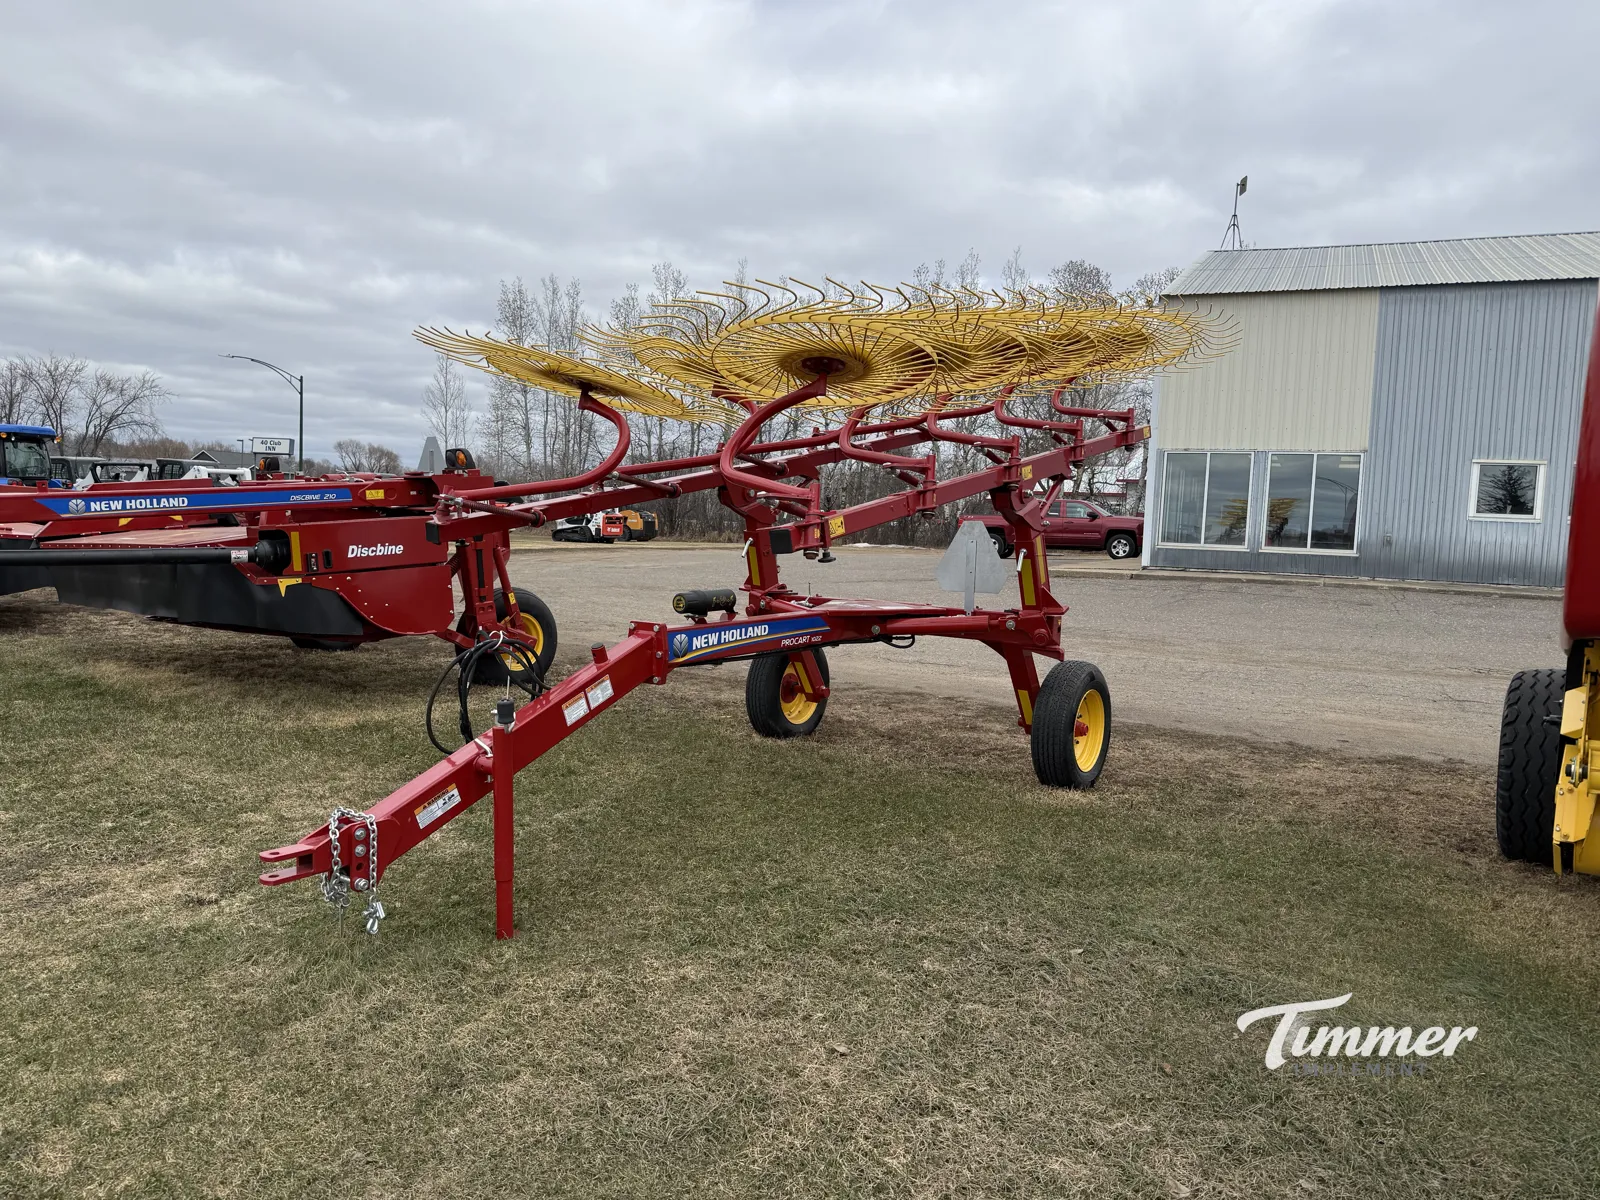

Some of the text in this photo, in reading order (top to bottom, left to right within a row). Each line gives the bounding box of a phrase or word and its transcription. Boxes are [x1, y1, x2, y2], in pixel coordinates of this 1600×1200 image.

[90, 497, 189, 512] NEW HOLLAND
[289, 494, 321, 502] DISCBINE
[347, 542, 404, 558] Discbine
[692, 624, 769, 650] NEW HOLLAND
[780, 635, 811, 648] PROCART
